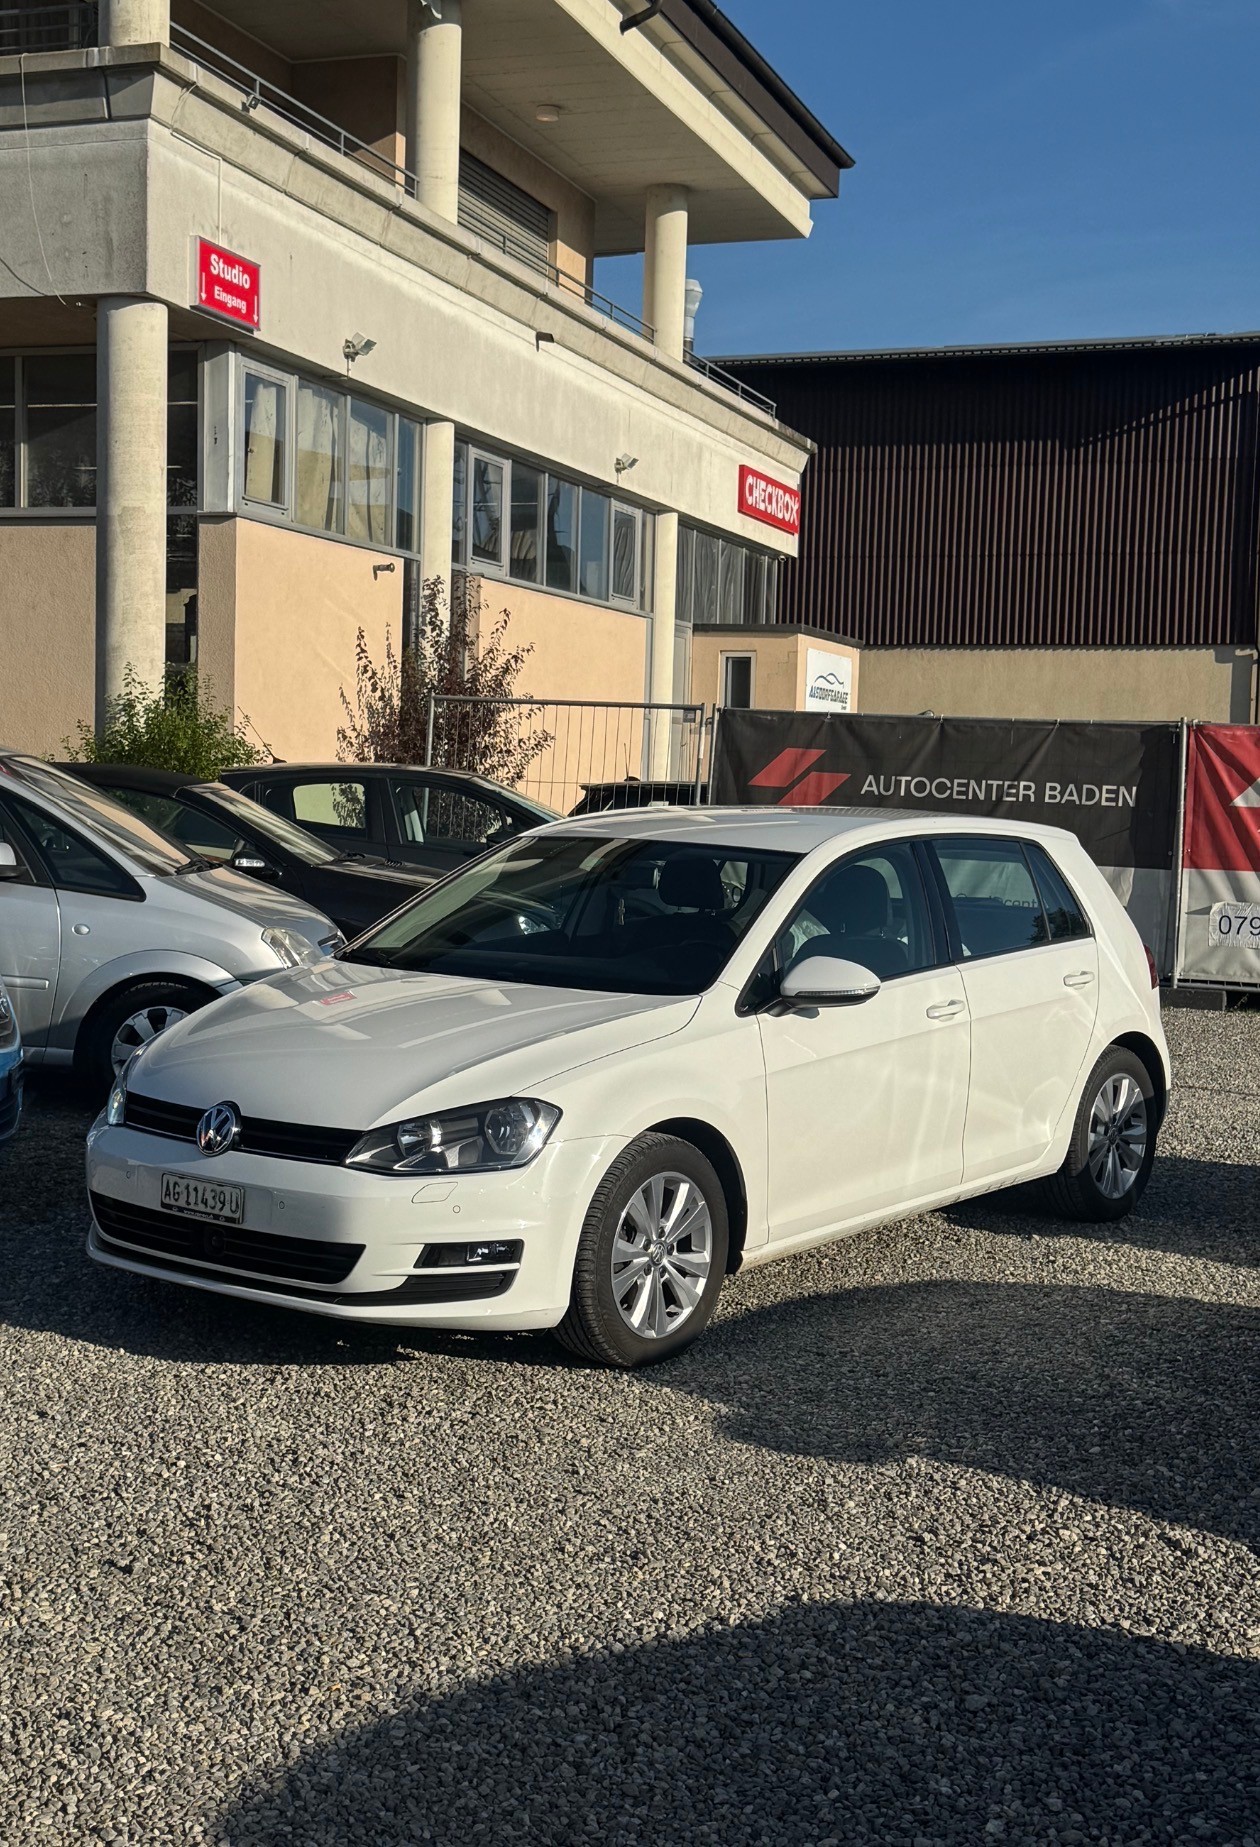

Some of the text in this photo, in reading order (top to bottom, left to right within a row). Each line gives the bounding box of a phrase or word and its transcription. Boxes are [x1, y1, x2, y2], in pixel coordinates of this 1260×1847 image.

[210, 253, 251, 289] Studio
[214, 285, 247, 314] Eingang
[745, 474, 799, 526] CHECKBOX
[861, 774, 1137, 807] AUTOCENTER BADEN
[1218, 914, 1260, 936] 079
